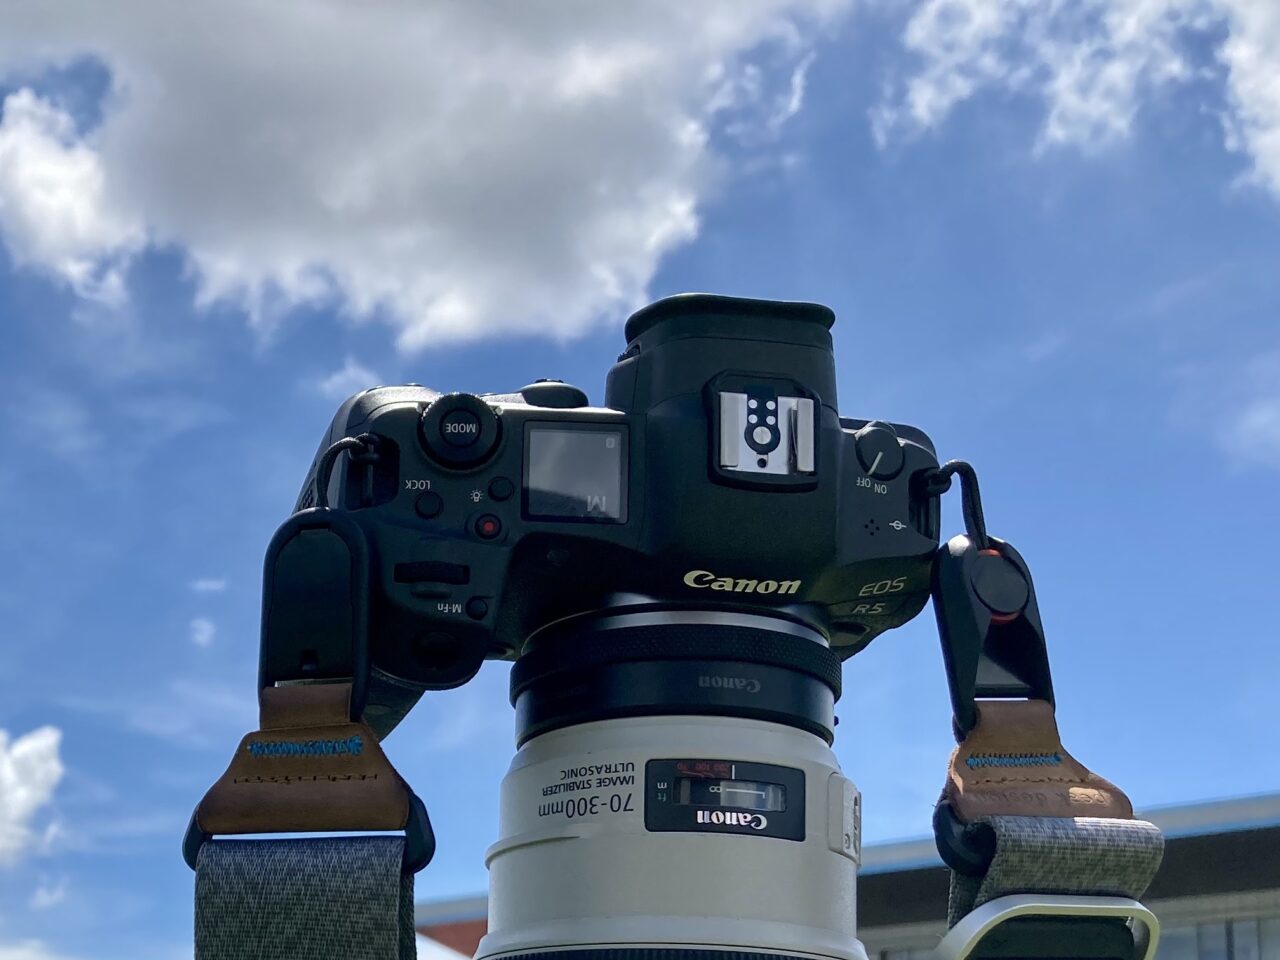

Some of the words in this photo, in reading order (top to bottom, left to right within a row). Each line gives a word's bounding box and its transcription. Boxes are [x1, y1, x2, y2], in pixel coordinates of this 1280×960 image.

[445, 423, 476, 433] MODE
[405, 479, 431, 490] LOCK
[856, 477, 871, 488] OFF
[874, 483, 888, 495] ON
[683, 570, 802, 595] Canon
[858, 576, 908, 597] EOS
[437, 603, 462, 613] M-Fn
[851, 602, 886, 615] R5
[698, 675, 761, 693] Canon
[560, 762, 635, 780] ULTRASONIC
[542, 779, 592, 796] STABILIZER
[596, 776, 635, 788] IMAGE
[538, 793, 635, 818] 70-300mm
[696, 810, 768, 830] Canon
